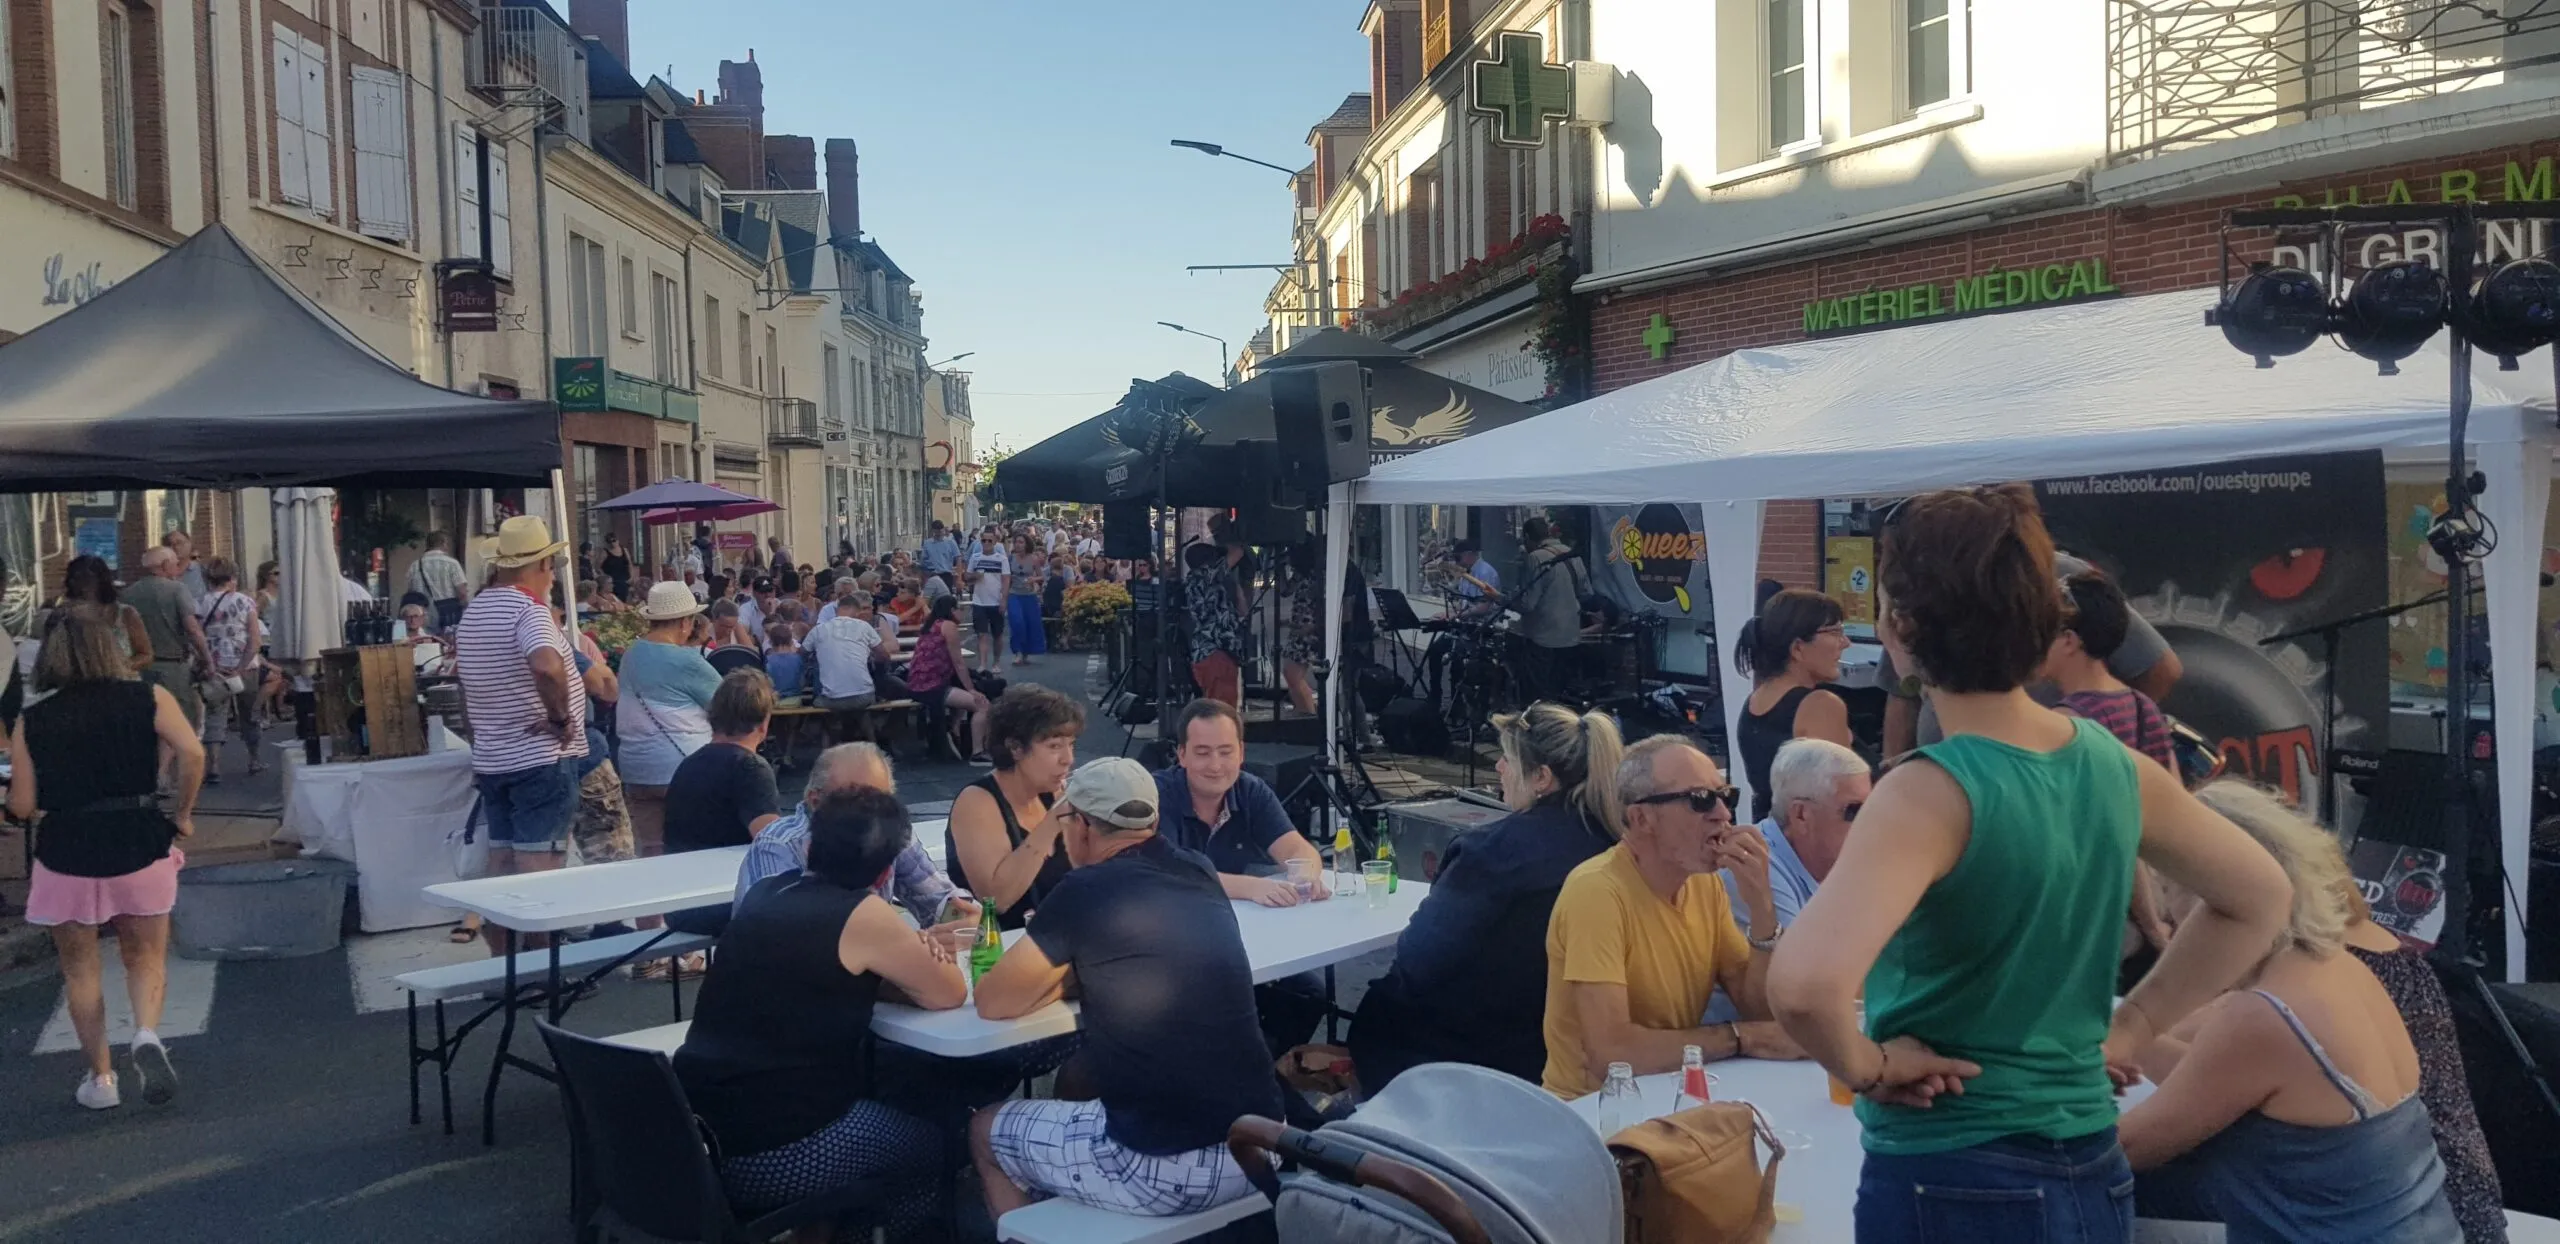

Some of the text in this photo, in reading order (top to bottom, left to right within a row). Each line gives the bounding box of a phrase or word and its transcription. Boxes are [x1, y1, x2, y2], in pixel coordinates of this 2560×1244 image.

[1802, 257, 2117, 332] MATÉRIEL MÉDICAL
[1487, 348, 1534, 387] Pâtissier
[2046, 471, 2312, 495] www.facebook.com/ouestgroupe
[2340, 754, 2380, 770] Roland
